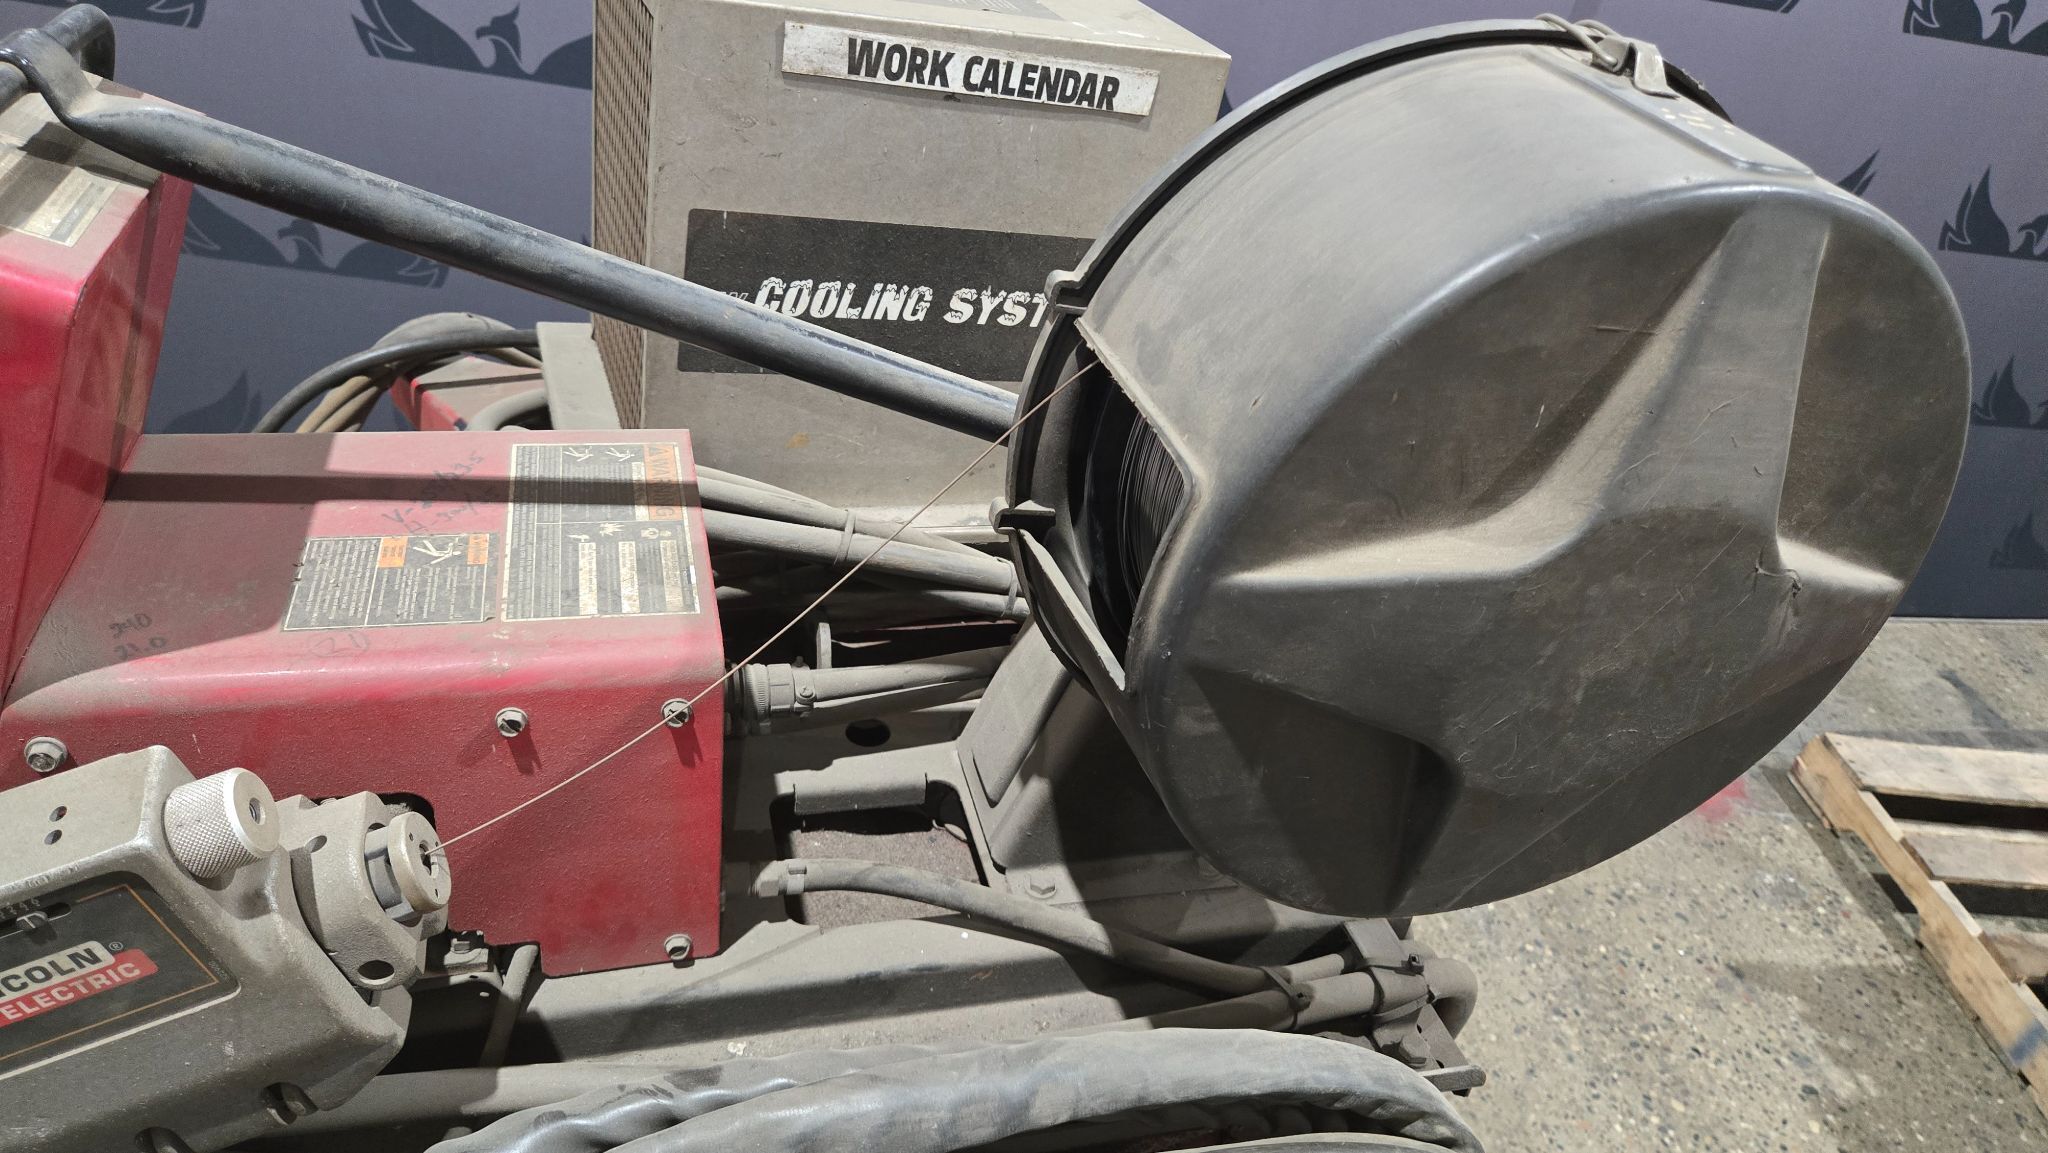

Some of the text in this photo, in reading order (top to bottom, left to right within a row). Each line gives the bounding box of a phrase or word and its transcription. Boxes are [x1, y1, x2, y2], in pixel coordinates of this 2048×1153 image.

[847, 37, 1121, 112] WORK CALENDAR
[755, 276, 1050, 328] COOLING SYST
[0, 946, 102, 998] COLN
[0, 961, 142, 1021] ELECTRIC
